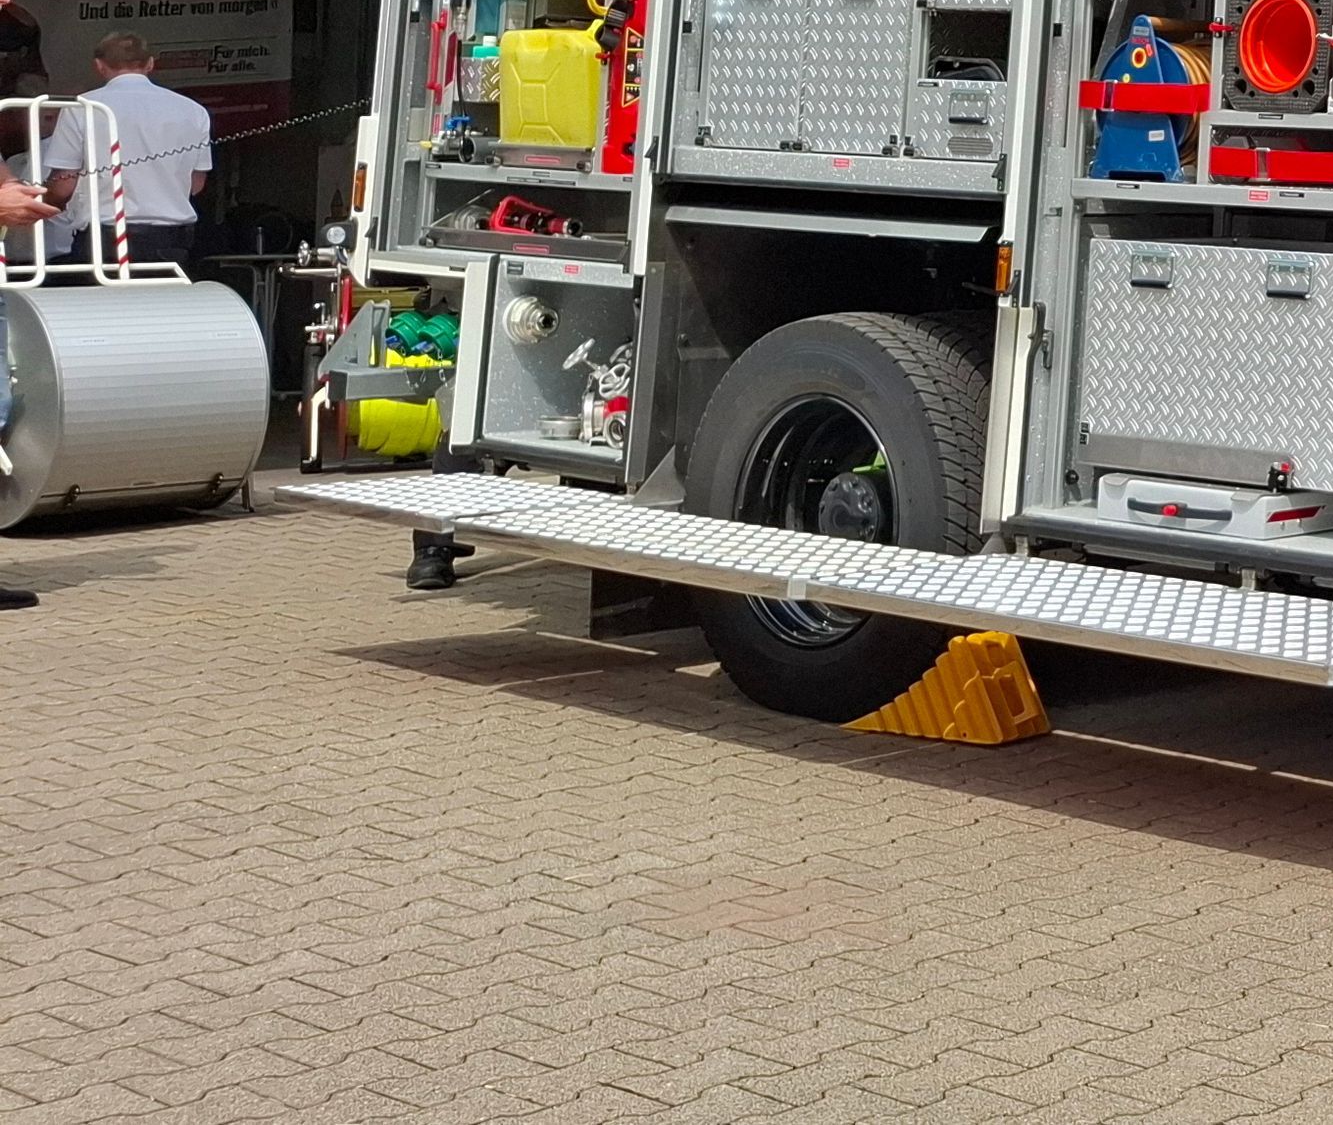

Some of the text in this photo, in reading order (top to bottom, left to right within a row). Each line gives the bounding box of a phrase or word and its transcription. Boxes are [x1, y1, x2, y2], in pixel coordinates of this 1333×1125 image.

[79, 2, 110, 21] Und
[114, 1, 134, 19] die
[139, 0, 186, 19] Retter
[190, 0, 215, 16] von
